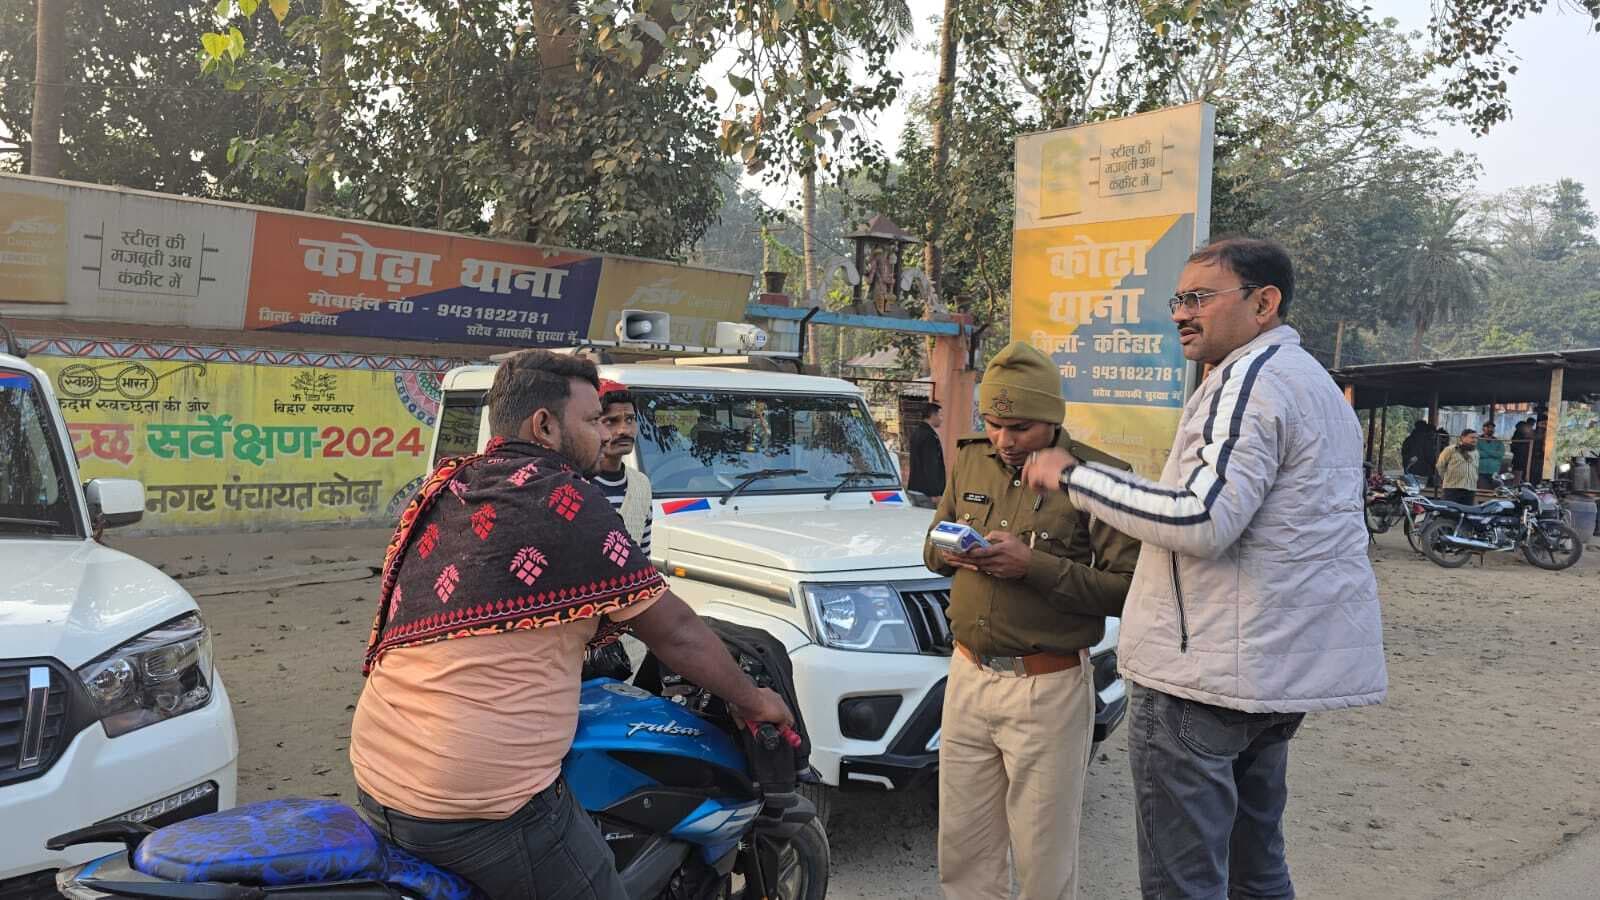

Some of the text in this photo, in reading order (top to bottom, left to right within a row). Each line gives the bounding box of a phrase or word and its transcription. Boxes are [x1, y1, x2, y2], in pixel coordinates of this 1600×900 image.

[121, 228, 186, 250] स्टील की
[111, 248, 192, 269] मजबूती अब
[298, 232, 569, 300] कोढ़ा थाना
[168, 272, 183, 289] में
[437, 303, 549, 325] 9431822781
[1050, 288, 1145, 326] थाना
[300, 311, 340, 327] कटिहार
[1093, 328, 1164, 354] कटिहार
[121, 377, 149, 389] भारत
[1091, 366, 1183, 381] 9431822781
[163, 396, 181, 411] की
[186, 397, 211, 412] ओर
[273, 400, 355, 416] बिहार सरकार
[145, 472, 383, 512] नगर पंचायत कोढ़ा
